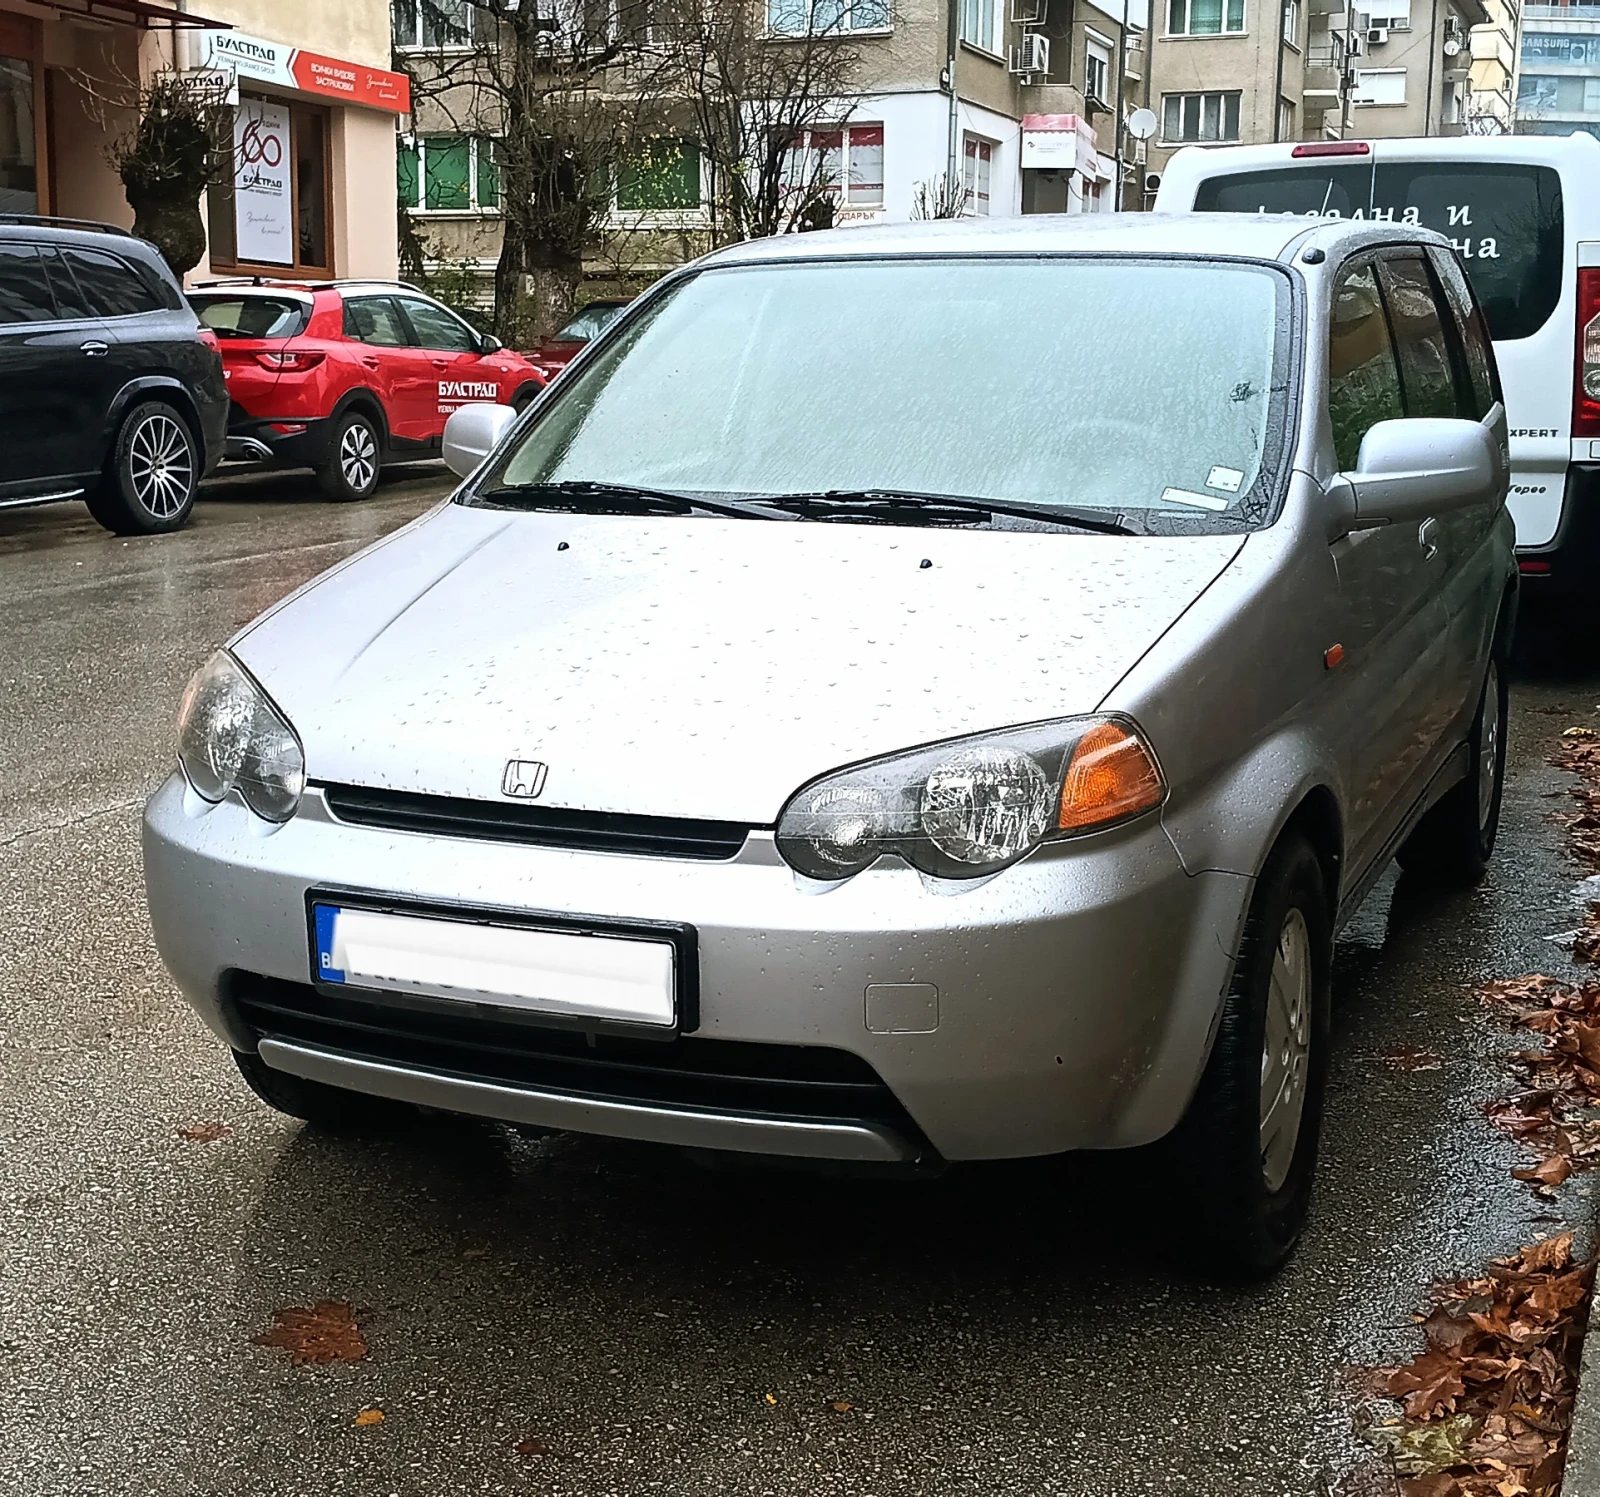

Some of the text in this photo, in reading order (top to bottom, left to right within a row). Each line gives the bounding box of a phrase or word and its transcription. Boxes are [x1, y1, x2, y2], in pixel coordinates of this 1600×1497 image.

[216, 35, 275, 61] БУЛСТРАД
[1521, 38, 1570, 48] SAMSUNG
[438, 381, 497, 397] БУЛСТРАД
[1508, 429, 1559, 437] XPERT
